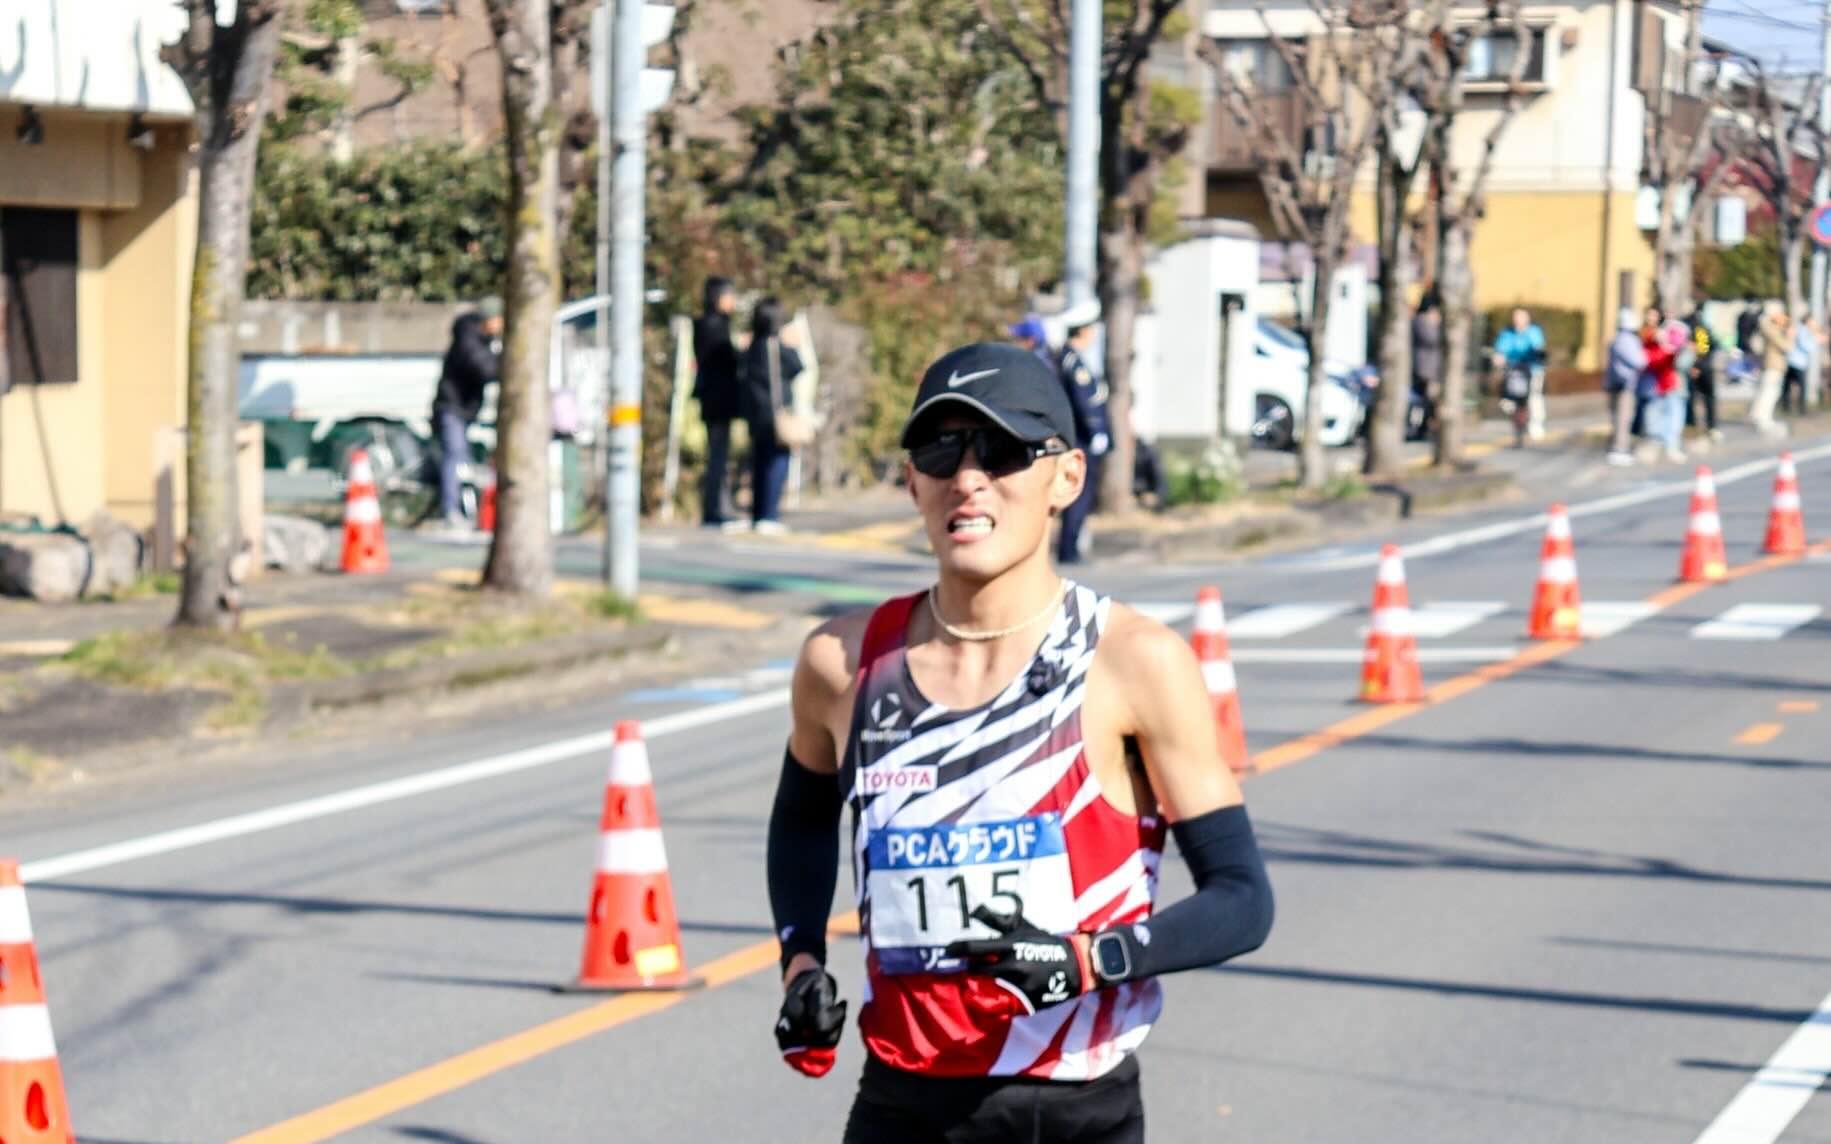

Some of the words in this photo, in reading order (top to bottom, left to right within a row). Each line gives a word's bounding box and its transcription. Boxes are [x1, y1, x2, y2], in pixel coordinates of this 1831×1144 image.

[887, 822, 1036, 866] PCAクラウド
[907, 868, 1023, 932] 115
[1012, 941, 1068, 962] TOYOTA
